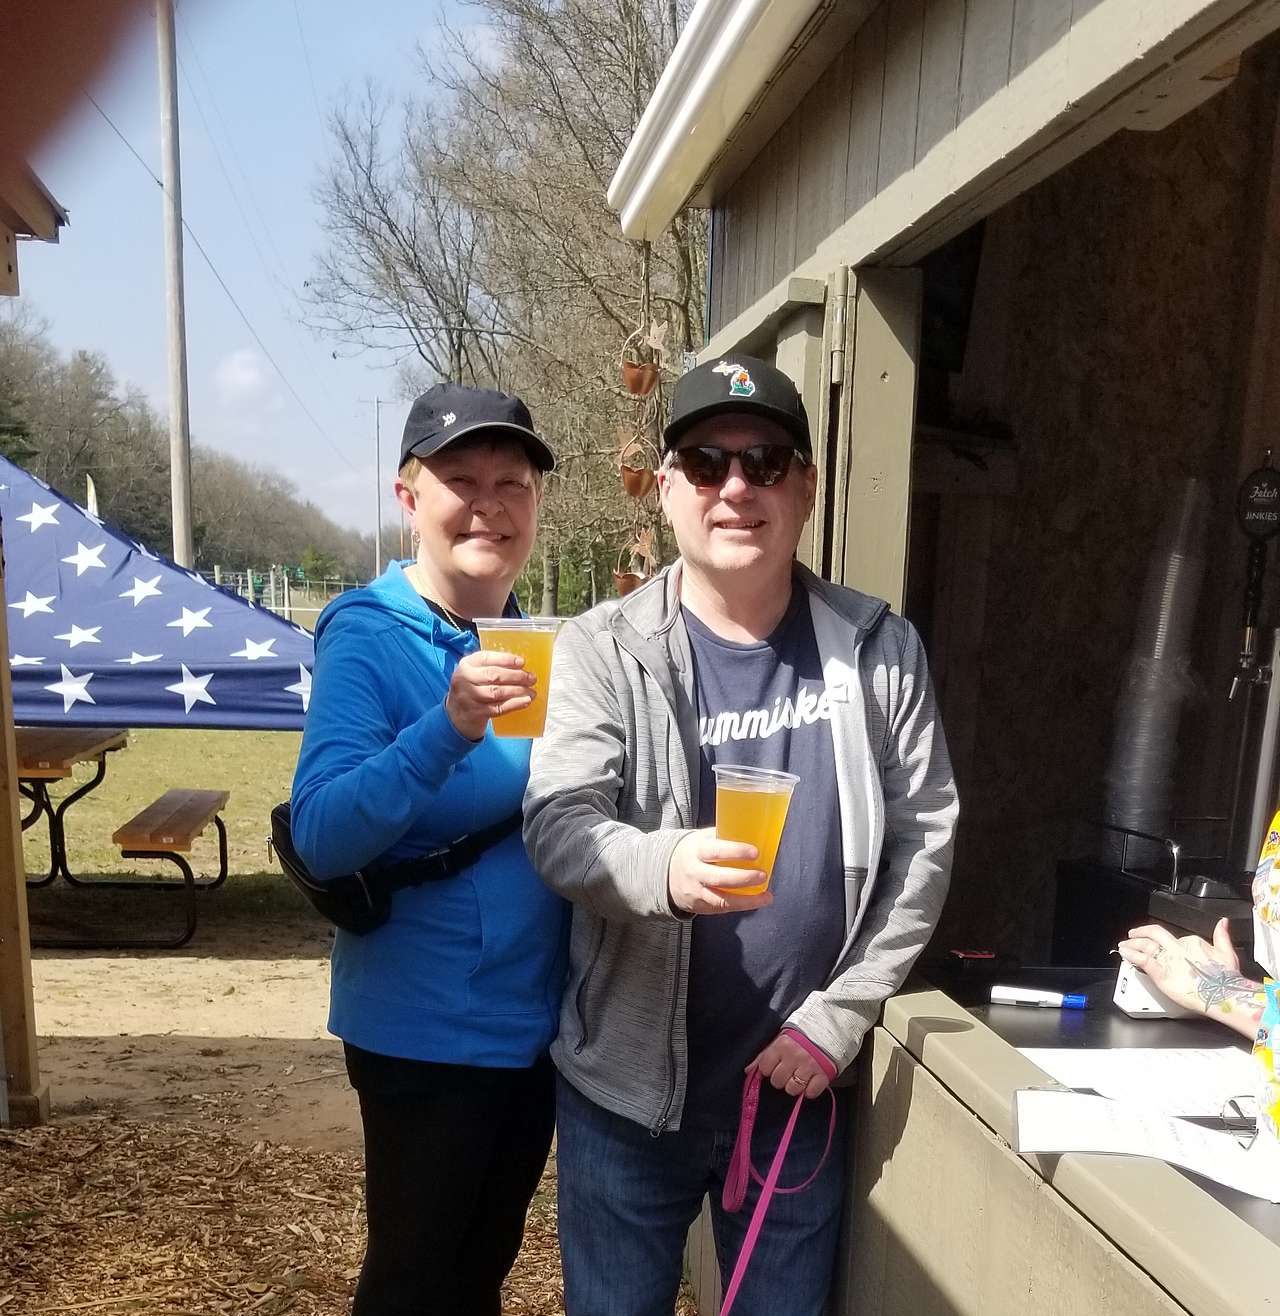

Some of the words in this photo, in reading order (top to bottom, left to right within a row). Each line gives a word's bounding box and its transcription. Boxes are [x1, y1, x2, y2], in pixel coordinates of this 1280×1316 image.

[1250, 486, 1278, 498] Fetch
[1245, 511, 1278, 521] JINKIES
[700, 686, 832, 745] ummiske
